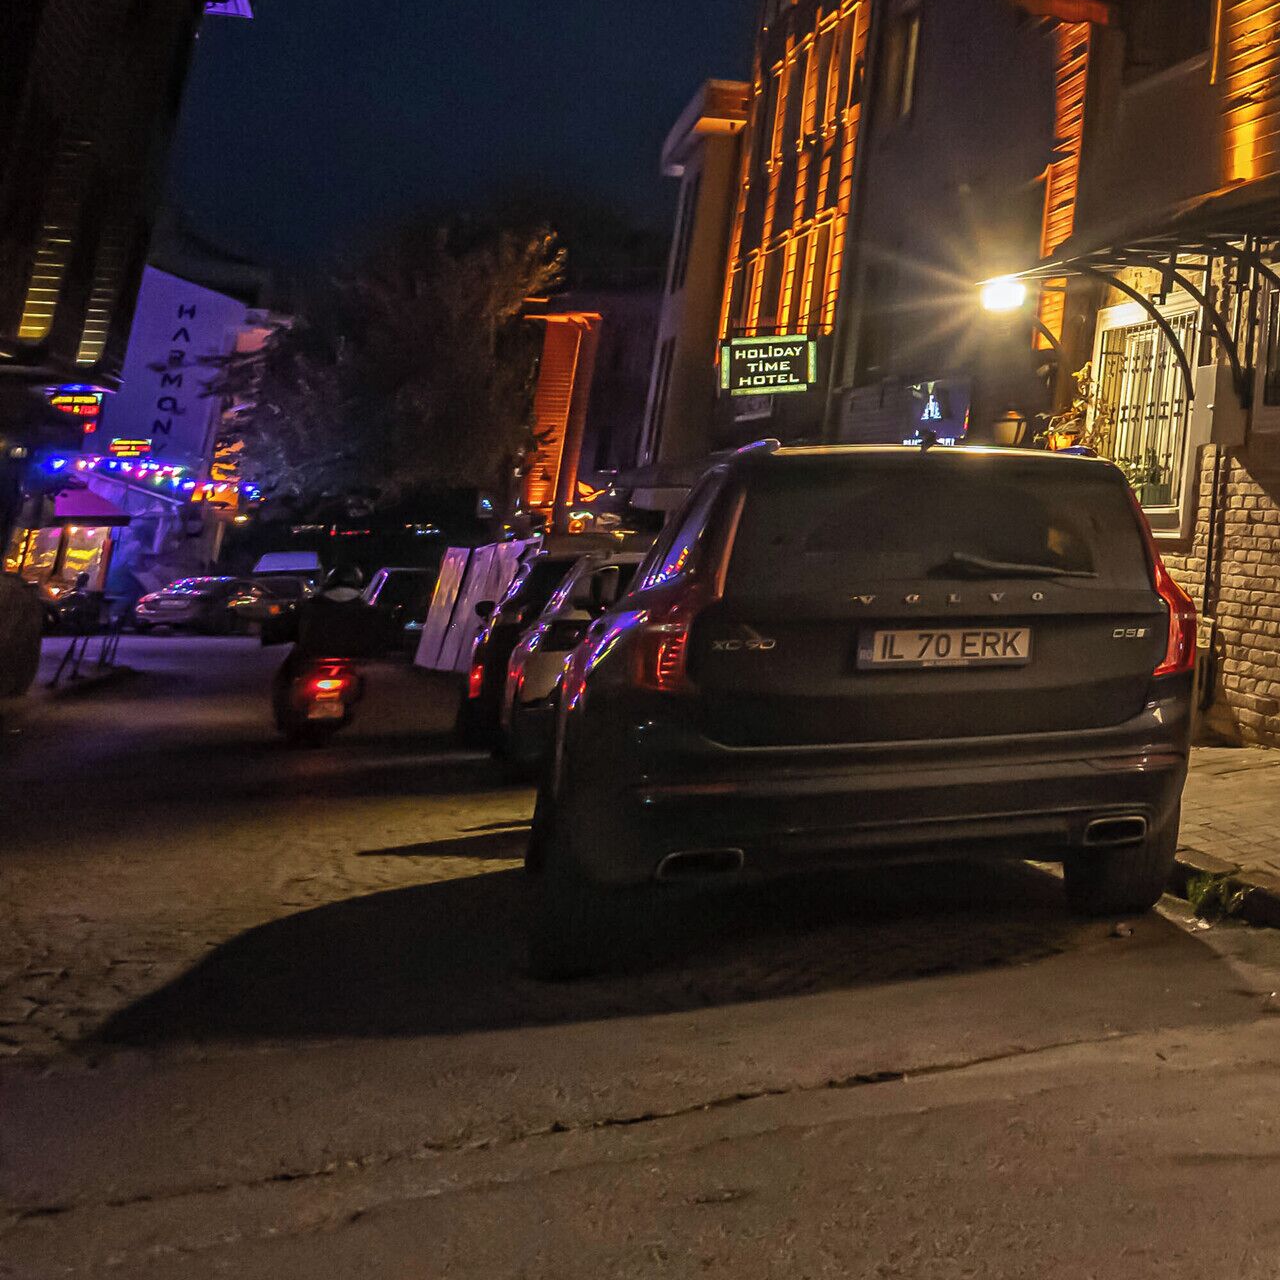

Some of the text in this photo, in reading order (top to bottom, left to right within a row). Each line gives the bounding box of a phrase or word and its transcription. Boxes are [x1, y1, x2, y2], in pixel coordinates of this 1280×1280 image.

[735, 345, 803, 360] HOLİDAY
[747, 360, 791, 373] TİME
[739, 373, 800, 387] HOTEL
[851, 592, 1044, 605] VOLVO
[881, 631, 1023, 660] IL 70 ERK
